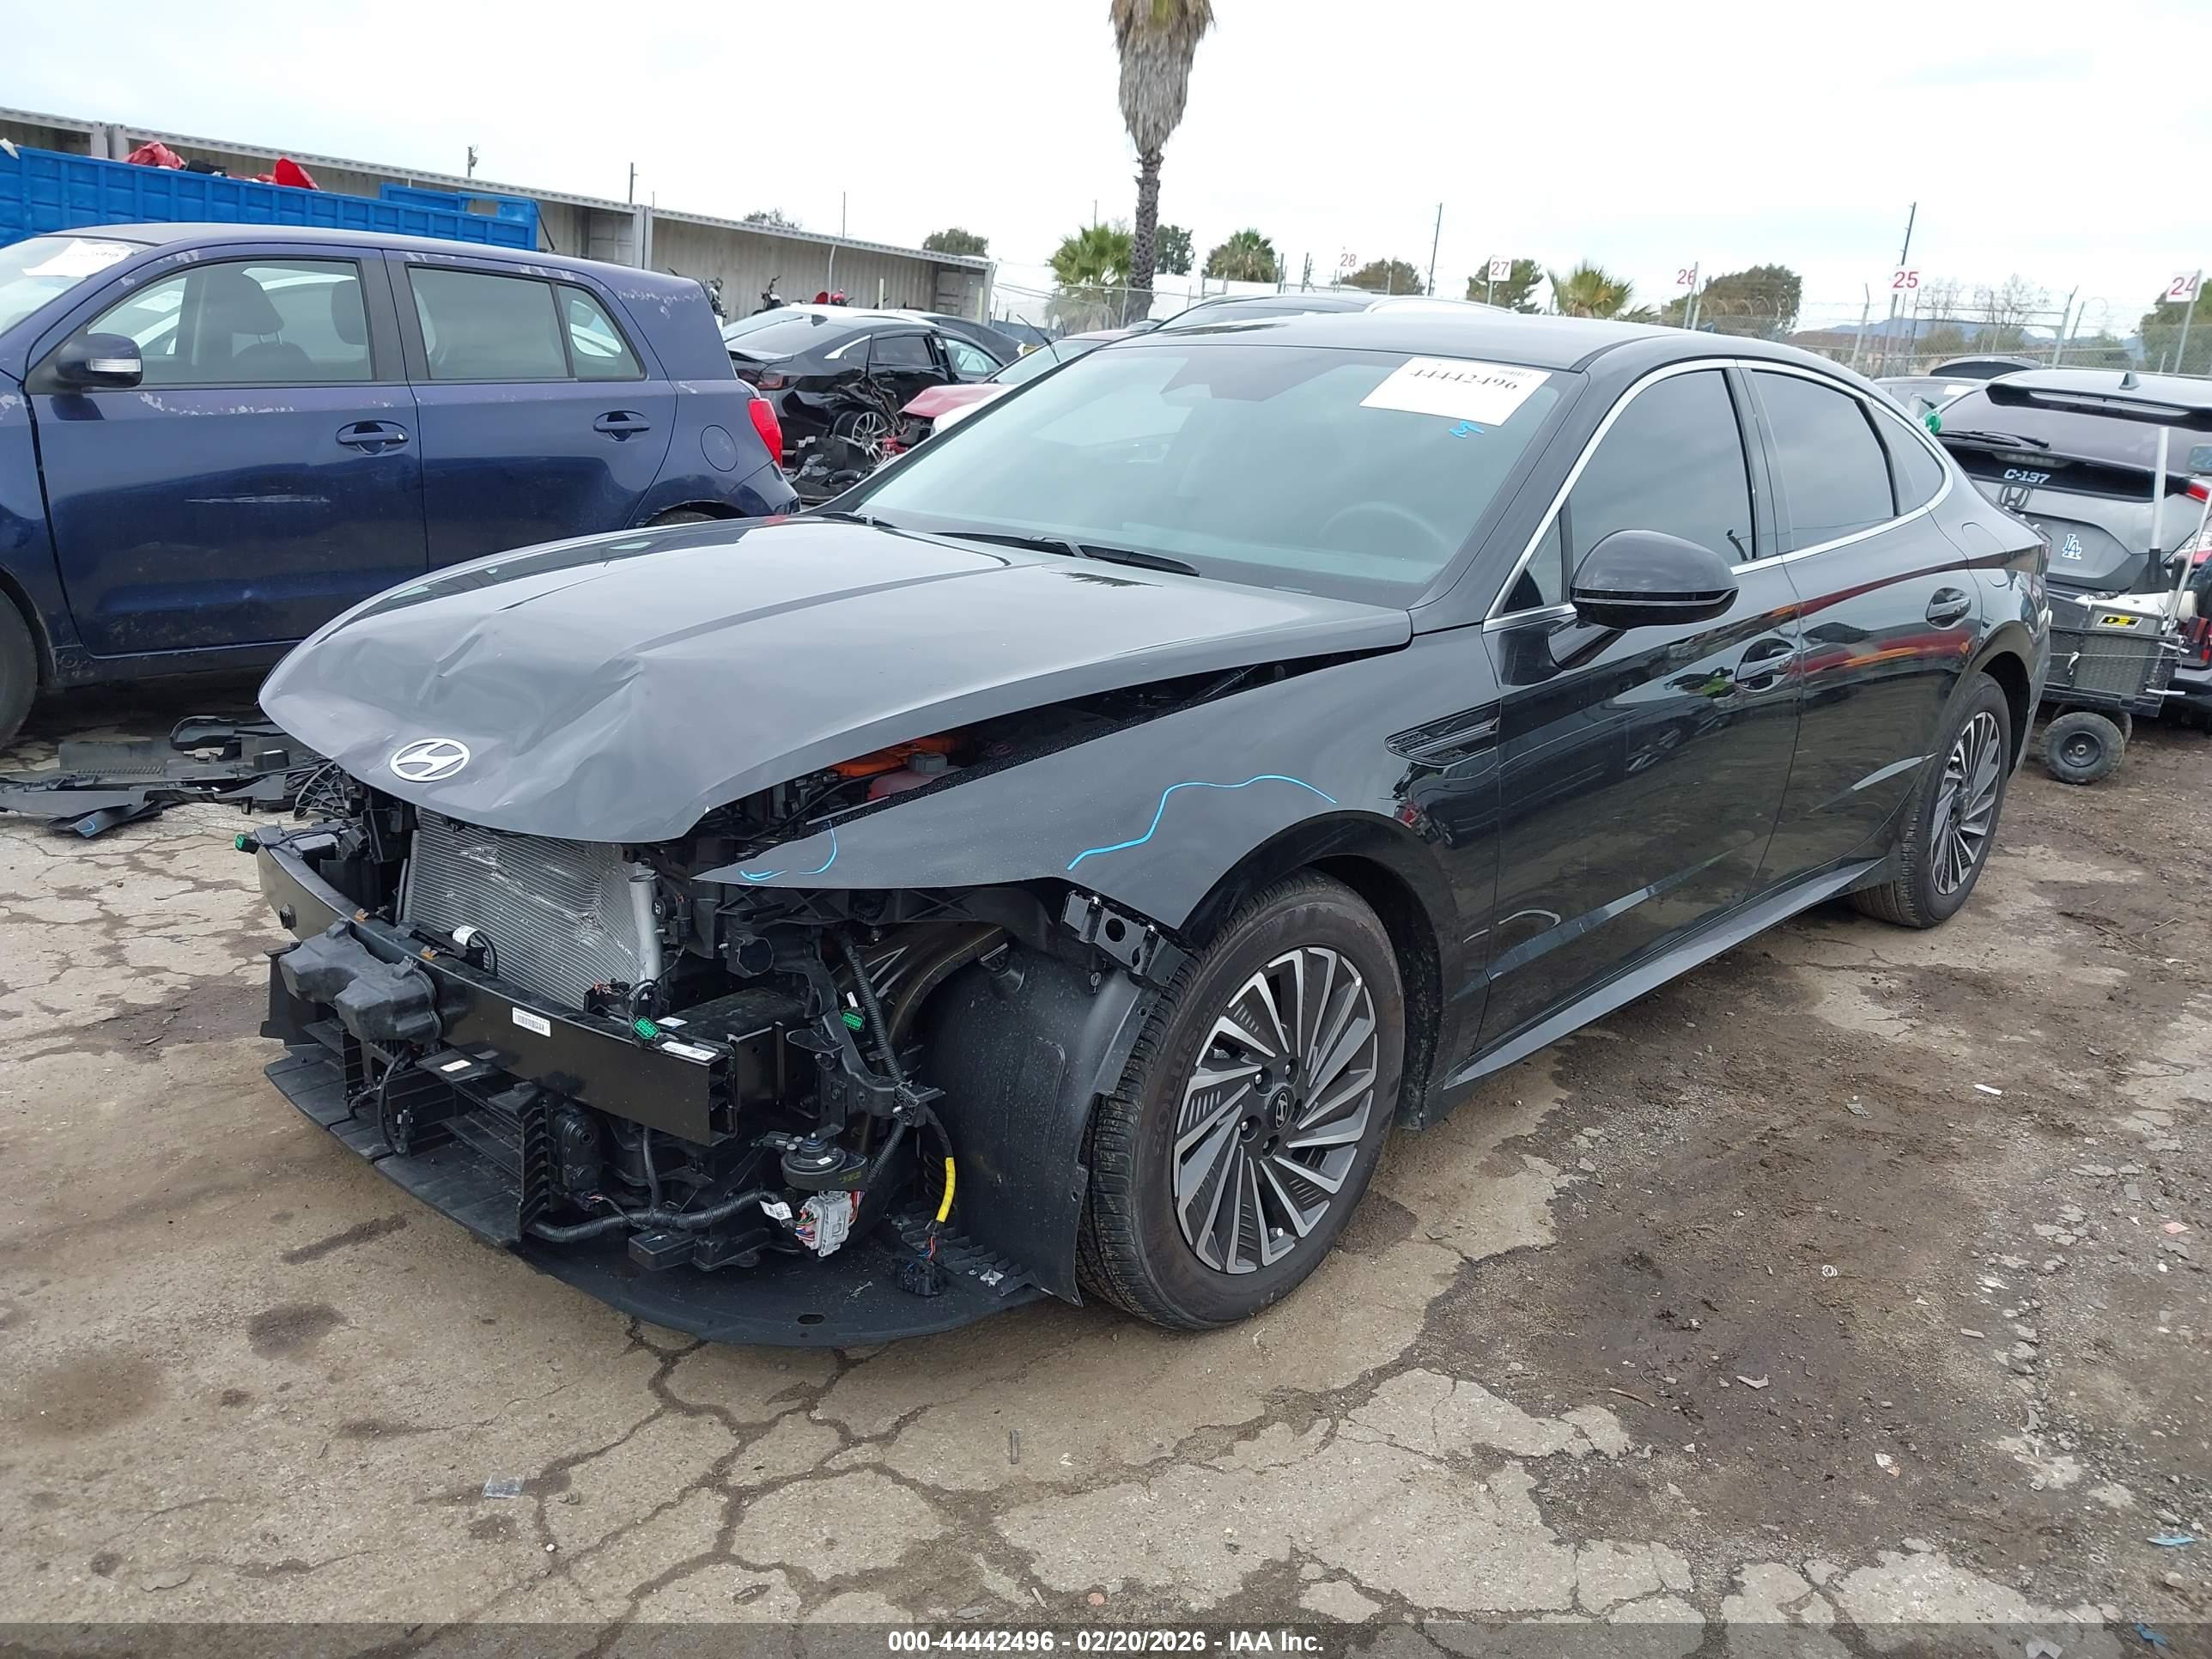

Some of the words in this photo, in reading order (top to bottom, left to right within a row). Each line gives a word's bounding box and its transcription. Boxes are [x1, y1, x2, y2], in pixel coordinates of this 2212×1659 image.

[1340, 253, 1357, 267] 28
[1491, 261, 1510, 276] 27
[1893, 270, 1919, 289] 25
[1409, 368, 1518, 390] 44442496
[2003, 468, 2051, 484] C-137
[2061, 533, 2082, 560] LA
